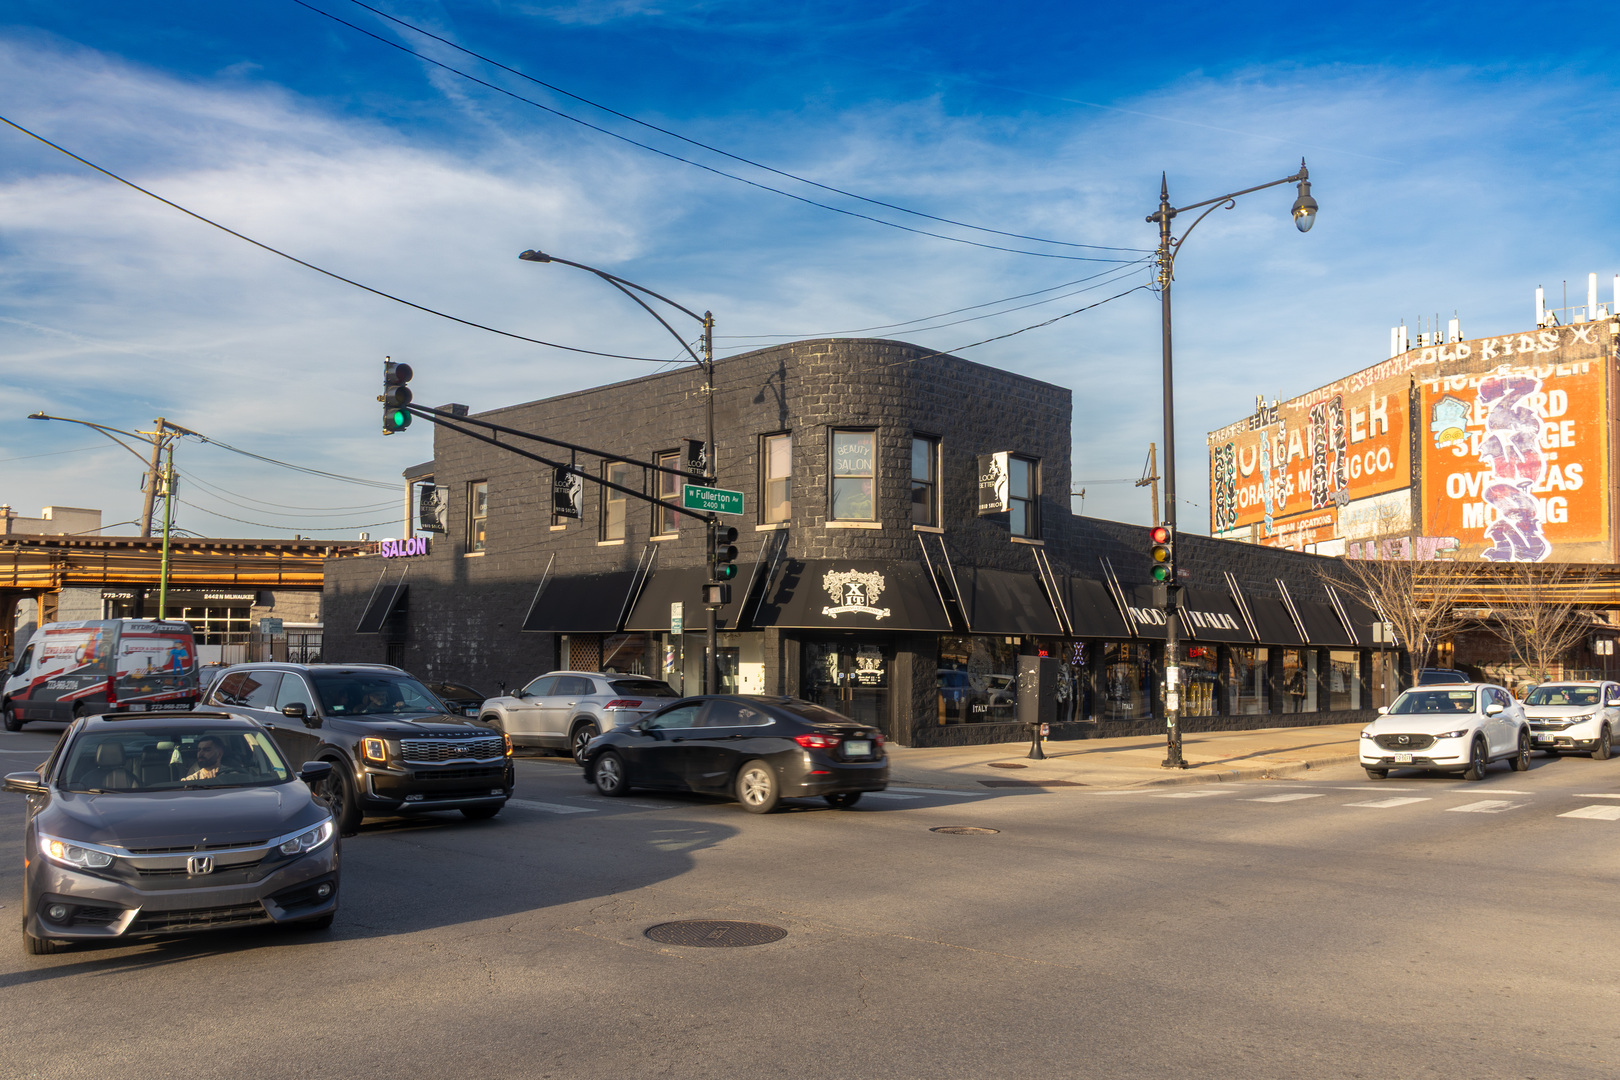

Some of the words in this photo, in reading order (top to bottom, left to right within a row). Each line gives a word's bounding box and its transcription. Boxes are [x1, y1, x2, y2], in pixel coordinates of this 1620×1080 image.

[1466, 389, 1568, 427] RERD
[1452, 420, 1575, 457] STGE
[837, 444, 870, 456] BEAUTY
[836, 458, 872, 471] SALON
[1364, 447, 1394, 475] CO.
[979, 481, 995, 489] BETTER
[696, 489, 730, 503] Fullerton
[703, 501, 718, 509] 2400
[1297, 515, 1332, 532] LOCATIONS
[381, 537, 427, 558] SALON
[1128, 606, 1167, 626] MOD
[1188, 610, 1240, 630] ITALIA
[972, 704, 988, 713] ITALY
